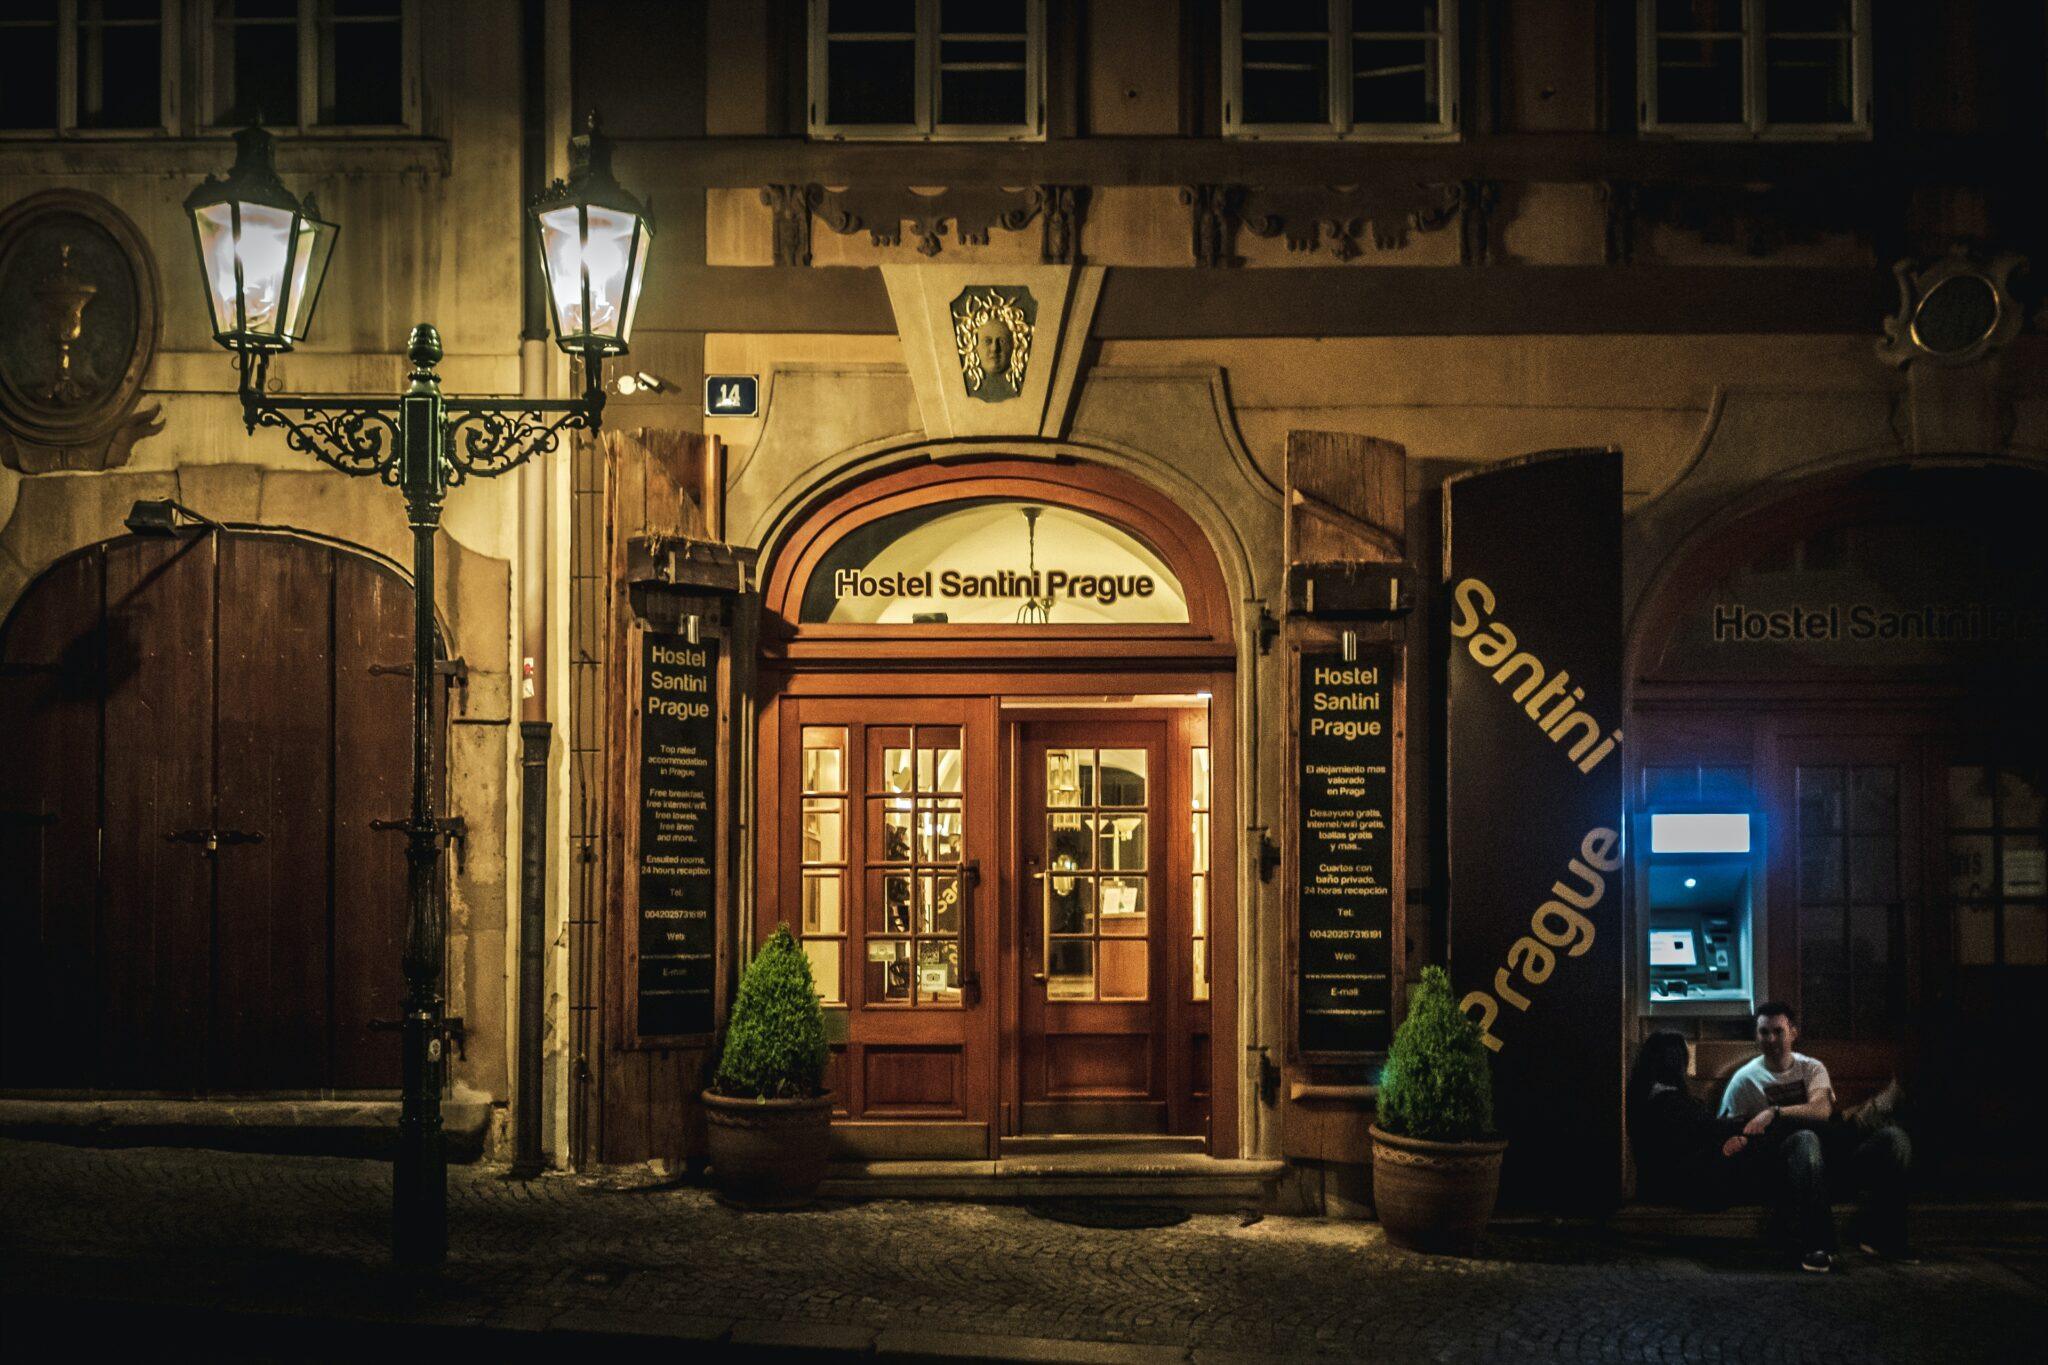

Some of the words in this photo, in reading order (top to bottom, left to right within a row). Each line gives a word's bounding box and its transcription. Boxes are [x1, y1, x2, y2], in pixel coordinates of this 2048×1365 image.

[719, 383, 741, 407] 14
[835, 568, 933, 600] Hostel
[939, 569, 1041, 601] Santini
[1046, 569, 1156, 606] Prague
[1713, 604, 1840, 642] Hostel
[1849, 602, 1983, 642] Santini
[652, 645, 706, 668] Hostel
[1314, 667, 1378, 686] Hostel
[1451, 577, 1624, 775] Santini
[651, 671, 707, 693] Santini
[1313, 692, 1380, 711] Santini
[648, 697, 709, 721] Prague
[1311, 718, 1381, 741] Prague
[660, 744, 675, 755] Top
[677, 746, 696, 755] rated
[648, 756, 708, 766] accommodation
[660, 767, 668, 775] in
[669, 768, 696, 778] Prague
[1306, 765, 1314, 774] El
[1316, 765, 1365, 775] alojamiento
[1327, 776, 1365, 785] valorado
[650, 788, 667, 797] Free
[1327, 787, 1338, 796] en
[1340, 787, 1366, 797] Praga
[1309, 809, 1354, 819] Desayuno
[656, 833, 671, 842] and
[1318, 831, 1347, 839] toallas
[1348, 831, 1373, 841] gratis
[1329, 843, 1336, 852] y
[641, 867, 651, 875] 24
[652, 867, 676, 875] hours
[677, 868, 711, 878] reception
[1319, 864, 1354, 872] Cuartos
[1355, 864, 1372, 872] con
[1315, 874, 1339, 884] baño
[1317, 886, 1342, 895] horas
[1459, 827, 1625, 1053] Prague
